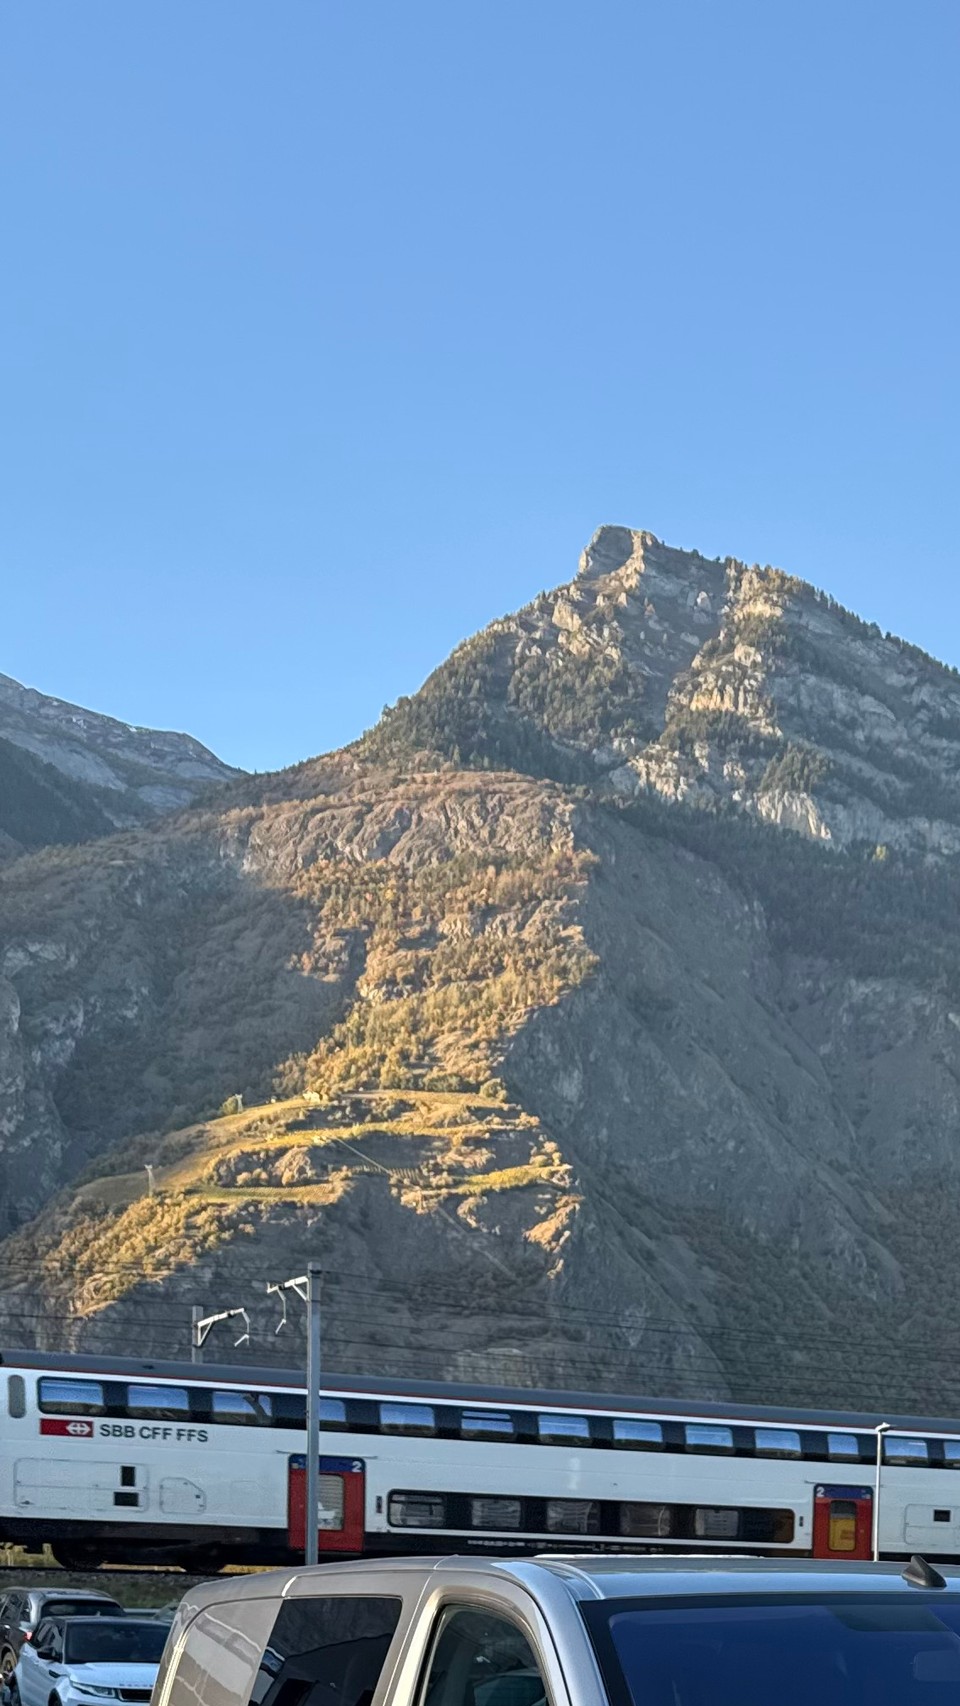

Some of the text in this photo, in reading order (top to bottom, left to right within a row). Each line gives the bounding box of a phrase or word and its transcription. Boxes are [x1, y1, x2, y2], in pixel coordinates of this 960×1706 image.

[100, 1424, 209, 1443] SBB CFF FFS
[351, 1461, 362, 1473] 2
[816, 1486, 825, 1497] 2
